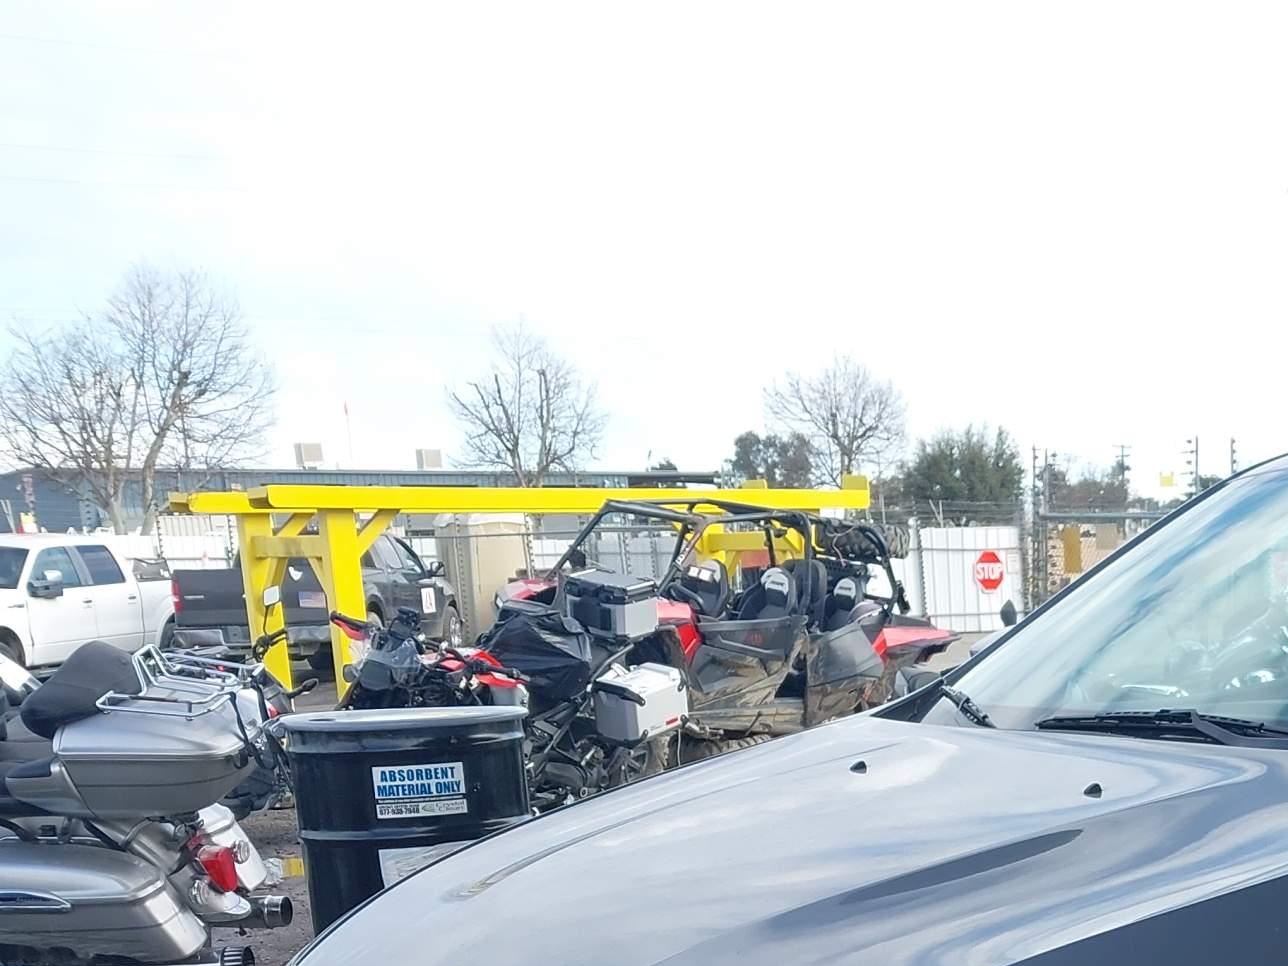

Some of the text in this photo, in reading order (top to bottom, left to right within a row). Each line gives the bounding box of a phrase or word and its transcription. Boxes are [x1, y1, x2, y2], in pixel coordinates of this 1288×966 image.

[976, 562, 1003, 580] STOP
[380, 766, 456, 783] ABSORBENT
[377, 780, 462, 797] MATERIAL ONLY
